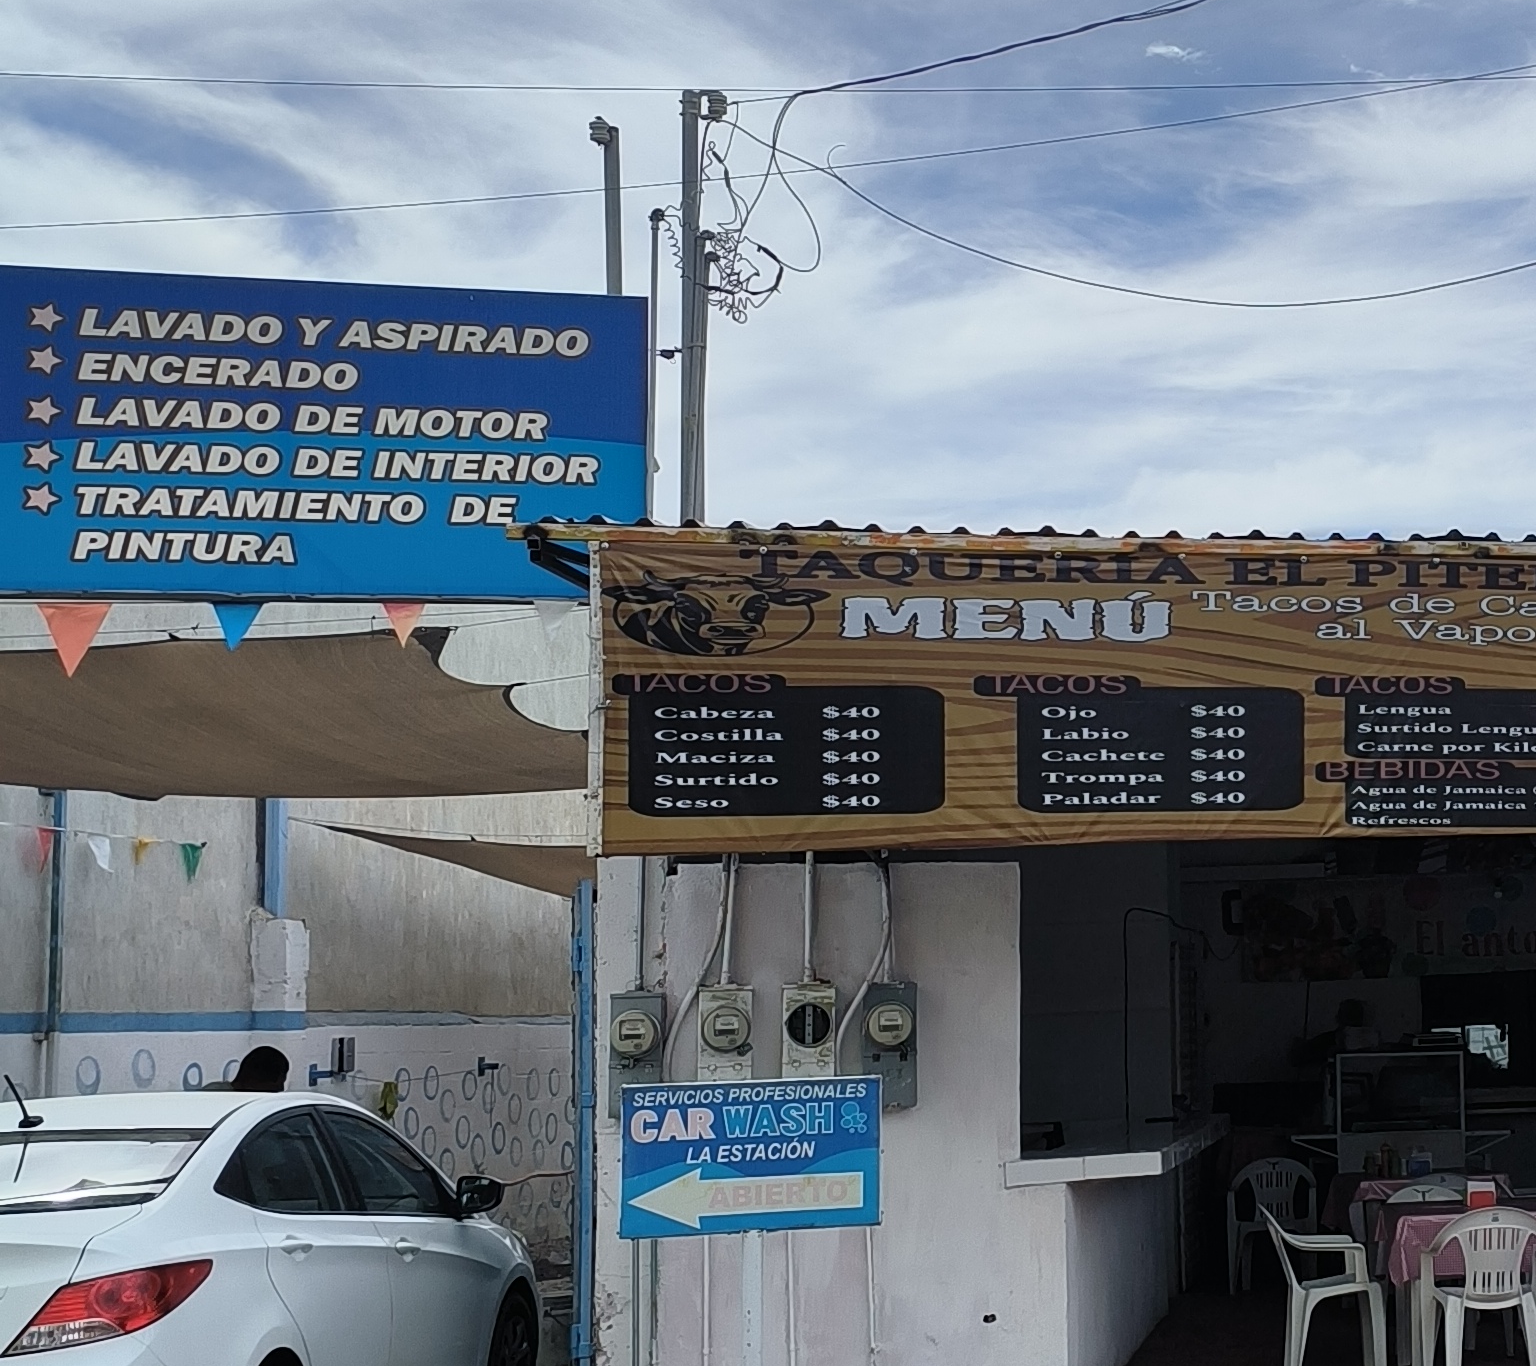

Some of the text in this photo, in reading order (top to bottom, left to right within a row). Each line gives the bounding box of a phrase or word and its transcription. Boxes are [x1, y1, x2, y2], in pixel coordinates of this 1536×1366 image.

[79, 308, 590, 357] LAVADO Y ASPIRADO
[77, 351, 359, 392] ENCERADO
[75, 397, 548, 440] LAVADO DE MOTOR
[74, 441, 599, 484] LAVADO DE INTERIOR
[75, 486, 517, 524] TRATAMIENTO DE
[72, 531, 297, 564] PINTURA
[1225, 557, 1328, 586] EL
[1192, 590, 1363, 615] Tacos
[1390, 593, 1457, 616] de
[839, 591, 1172, 643] MENÚ
[1316, 619, 1373, 641] al
[630, 673, 772, 694] TACOS
[988, 673, 1128, 695] TACOS
[1326, 676, 1452, 695] TACOS
[654, 705, 880, 721] Cabeza $40
[1041, 704, 1246, 722] Ojo $40
[1357, 704, 1452, 718] Lengua
[654, 727, 880, 743] Costilla $40
[1041, 726, 1246, 741] Labio $40
[1356, 722, 1453, 736] Surtido
[655, 750, 880, 765] Maciza $40
[1041, 747, 1246, 763] Cachete $40
[1356, 741, 1434, 754] Carne
[1441, 744, 1486, 757] por
[654, 771, 880, 787] Surtido $40
[1041, 769, 1246, 787] Trompa $40
[1325, 760, 1501, 781] BEBIDAS
[653, 793, 880, 810] Seso $40
[1041, 791, 1246, 806] Paladar $40
[1351, 784, 1408, 798] Agua
[1411, 784, 1439, 796] de
[1443, 784, 1528, 797] Jamaica
[1351, 799, 1408, 813] Agua
[1411, 799, 1439, 811] de
[1443, 799, 1528, 812] Jamaica
[1351, 815, 1452, 827] Refrescos
[1416, 921, 1445, 956] El
[632, 1083, 867, 1107] SERVICIOS PROFESIONALES
[630, 1102, 833, 1143] CAR WASH
[686, 1138, 815, 1164] LA ESTACIÓN
[709, 1181, 848, 1208] ABIERTO
